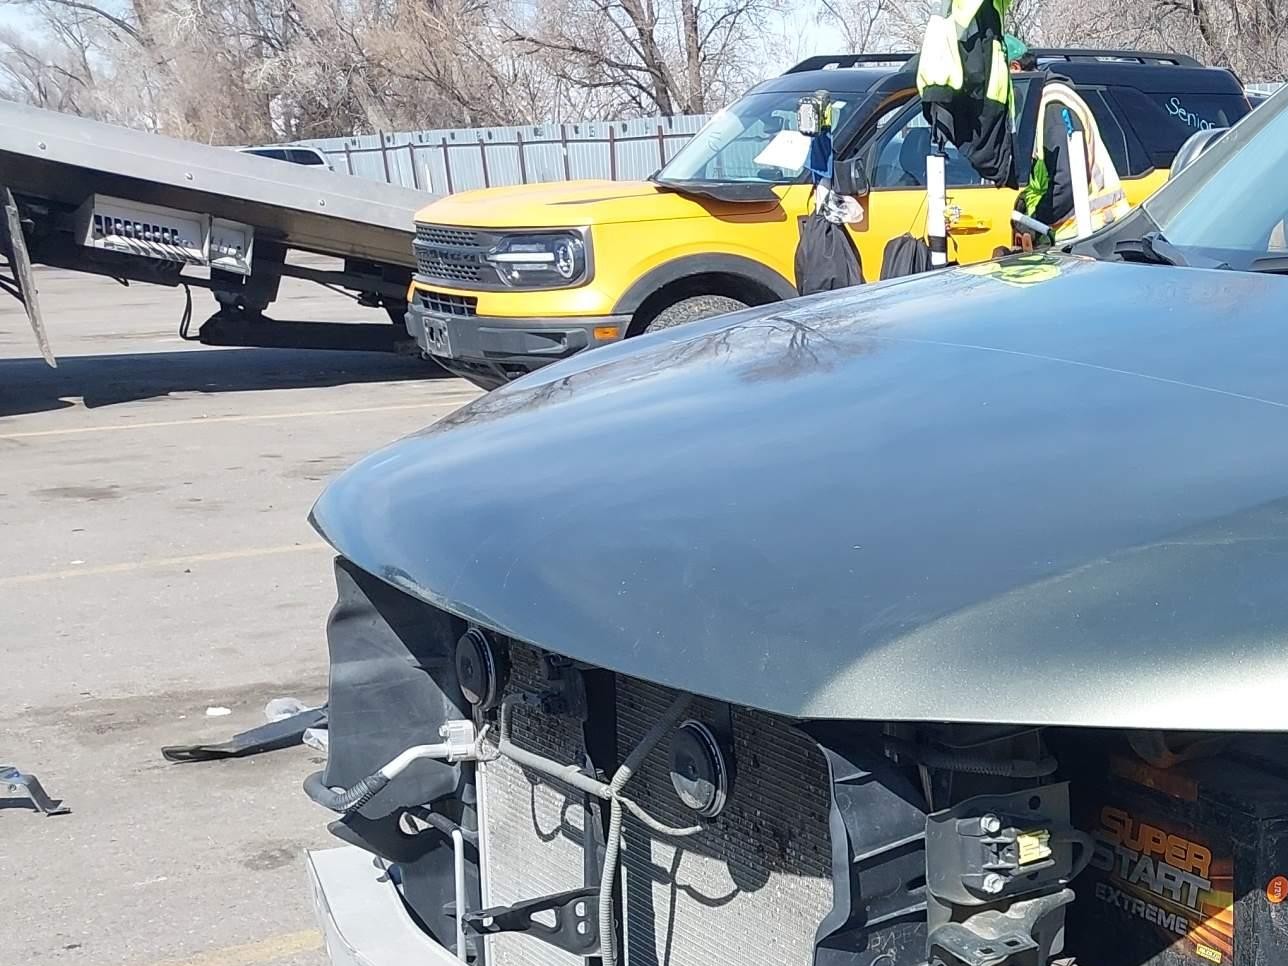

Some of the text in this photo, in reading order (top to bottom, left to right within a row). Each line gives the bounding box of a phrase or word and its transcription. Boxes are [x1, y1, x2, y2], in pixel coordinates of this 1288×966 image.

[1165, 97, 1216, 130] Senior
[1092, 834, 1212, 908] START
[1102, 806, 1212, 879] SUPER
[1095, 882, 1189, 936] EXTREME
